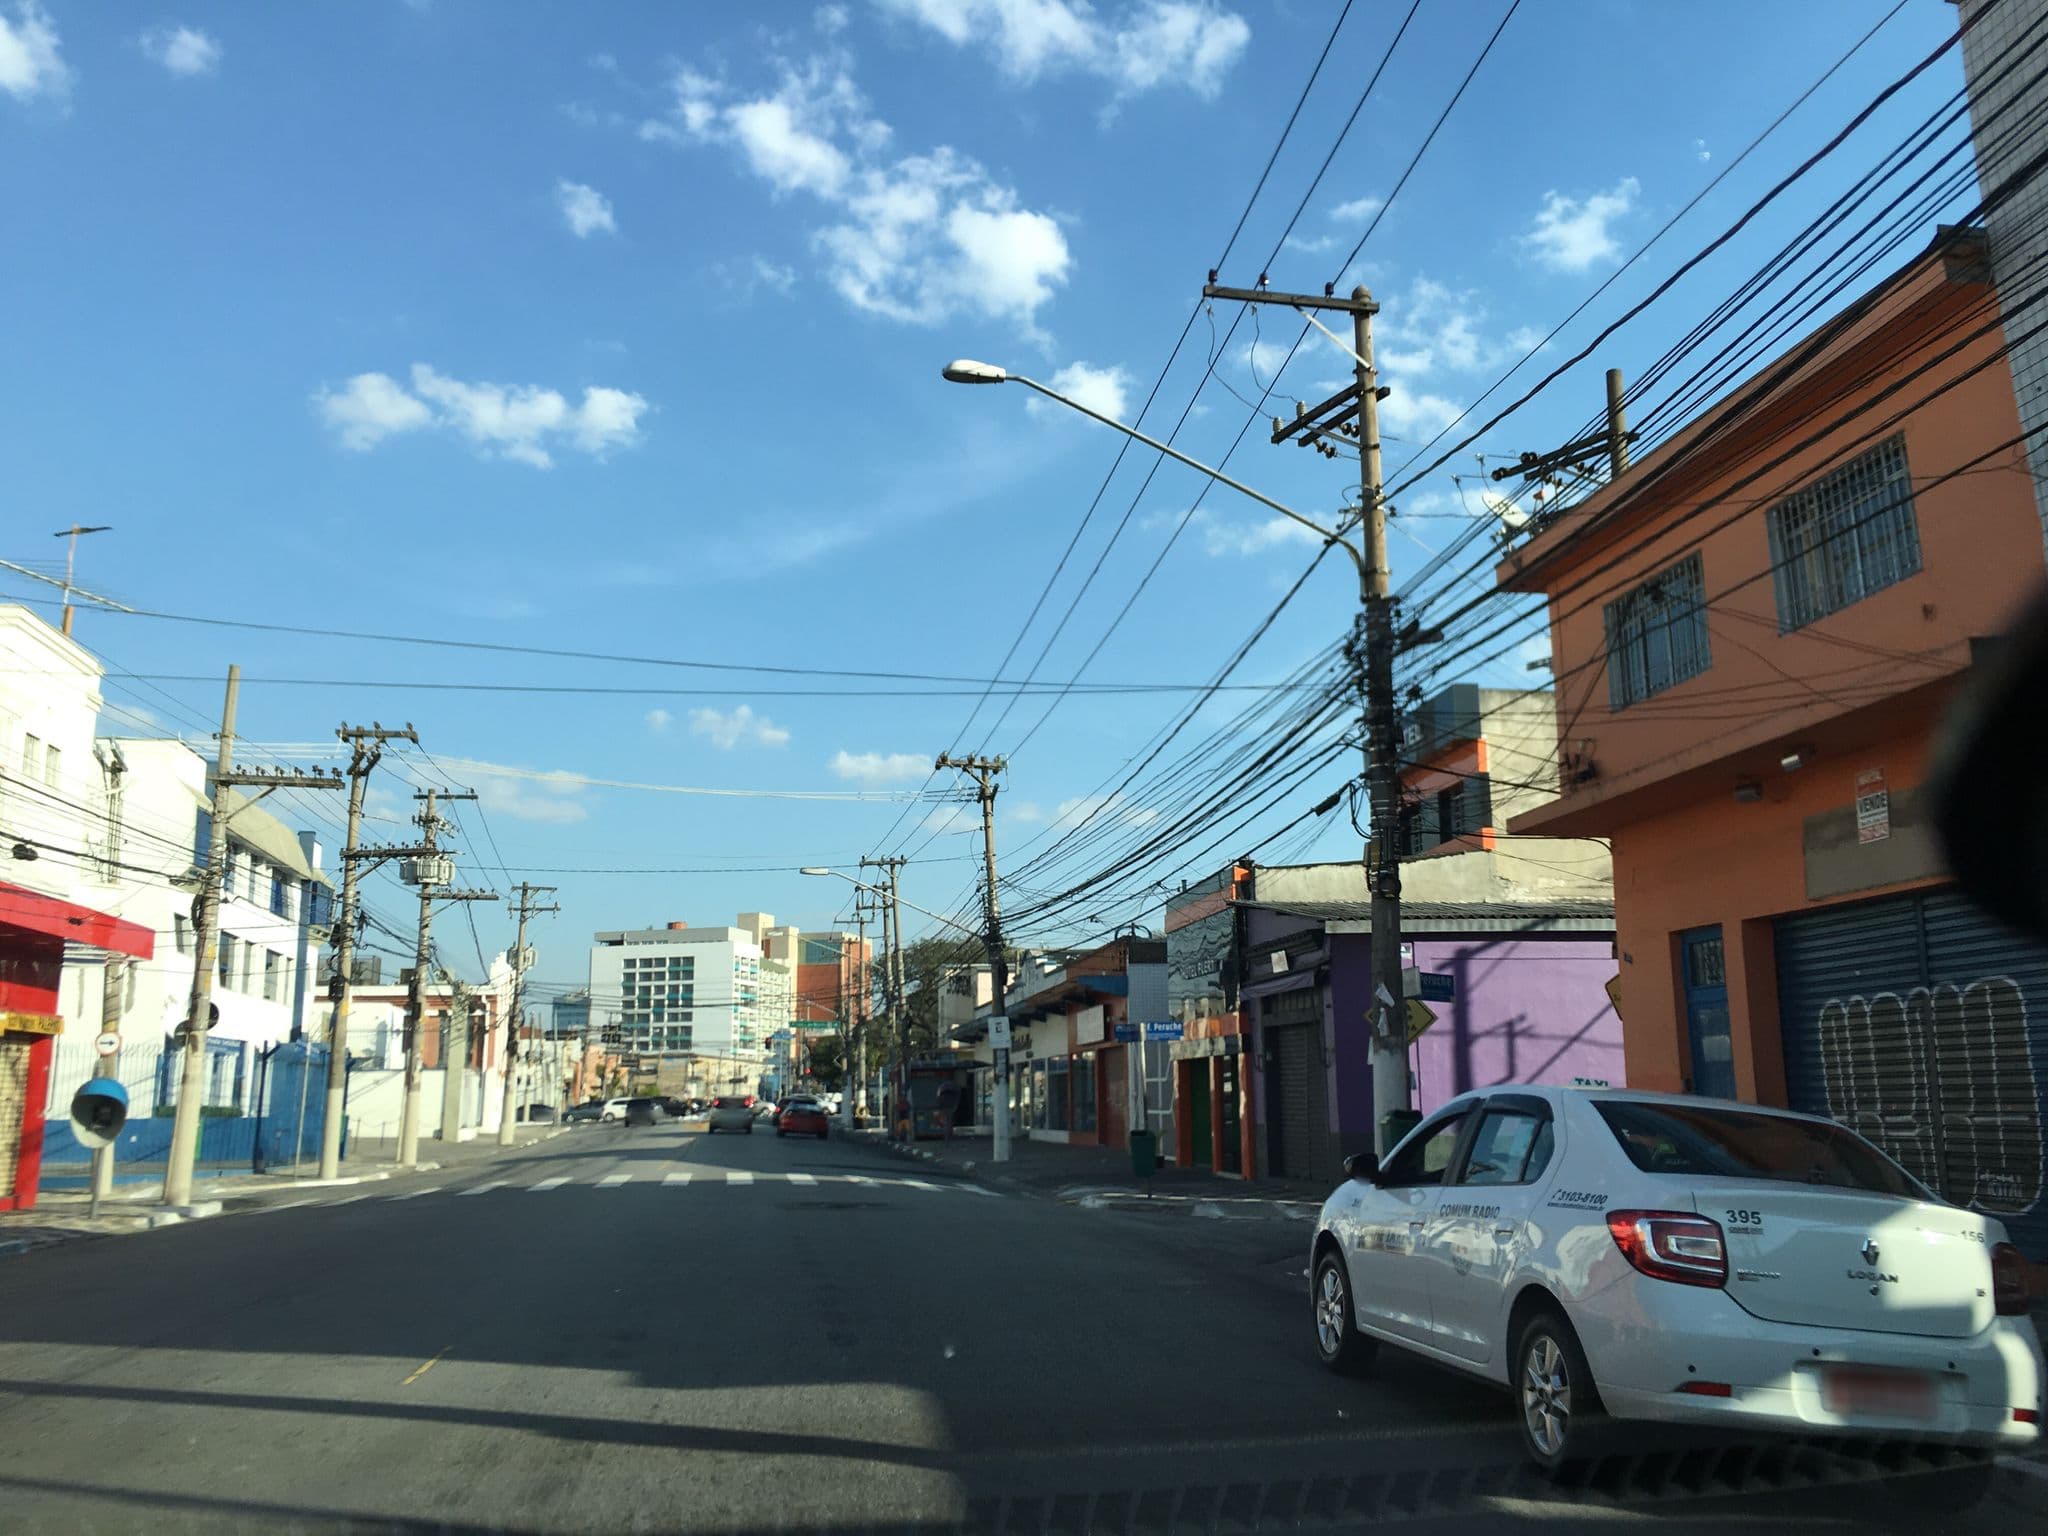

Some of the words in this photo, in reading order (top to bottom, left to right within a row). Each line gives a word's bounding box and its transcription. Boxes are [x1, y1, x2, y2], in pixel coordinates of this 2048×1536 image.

[1153, 1022, 1182, 1032] Peruche
[1439, 1203, 1472, 1218] COMUM
[1726, 1209, 1762, 1226] 395
[1961, 1230, 1985, 1243] 156
[1847, 1269, 1899, 1283] LOGAN
